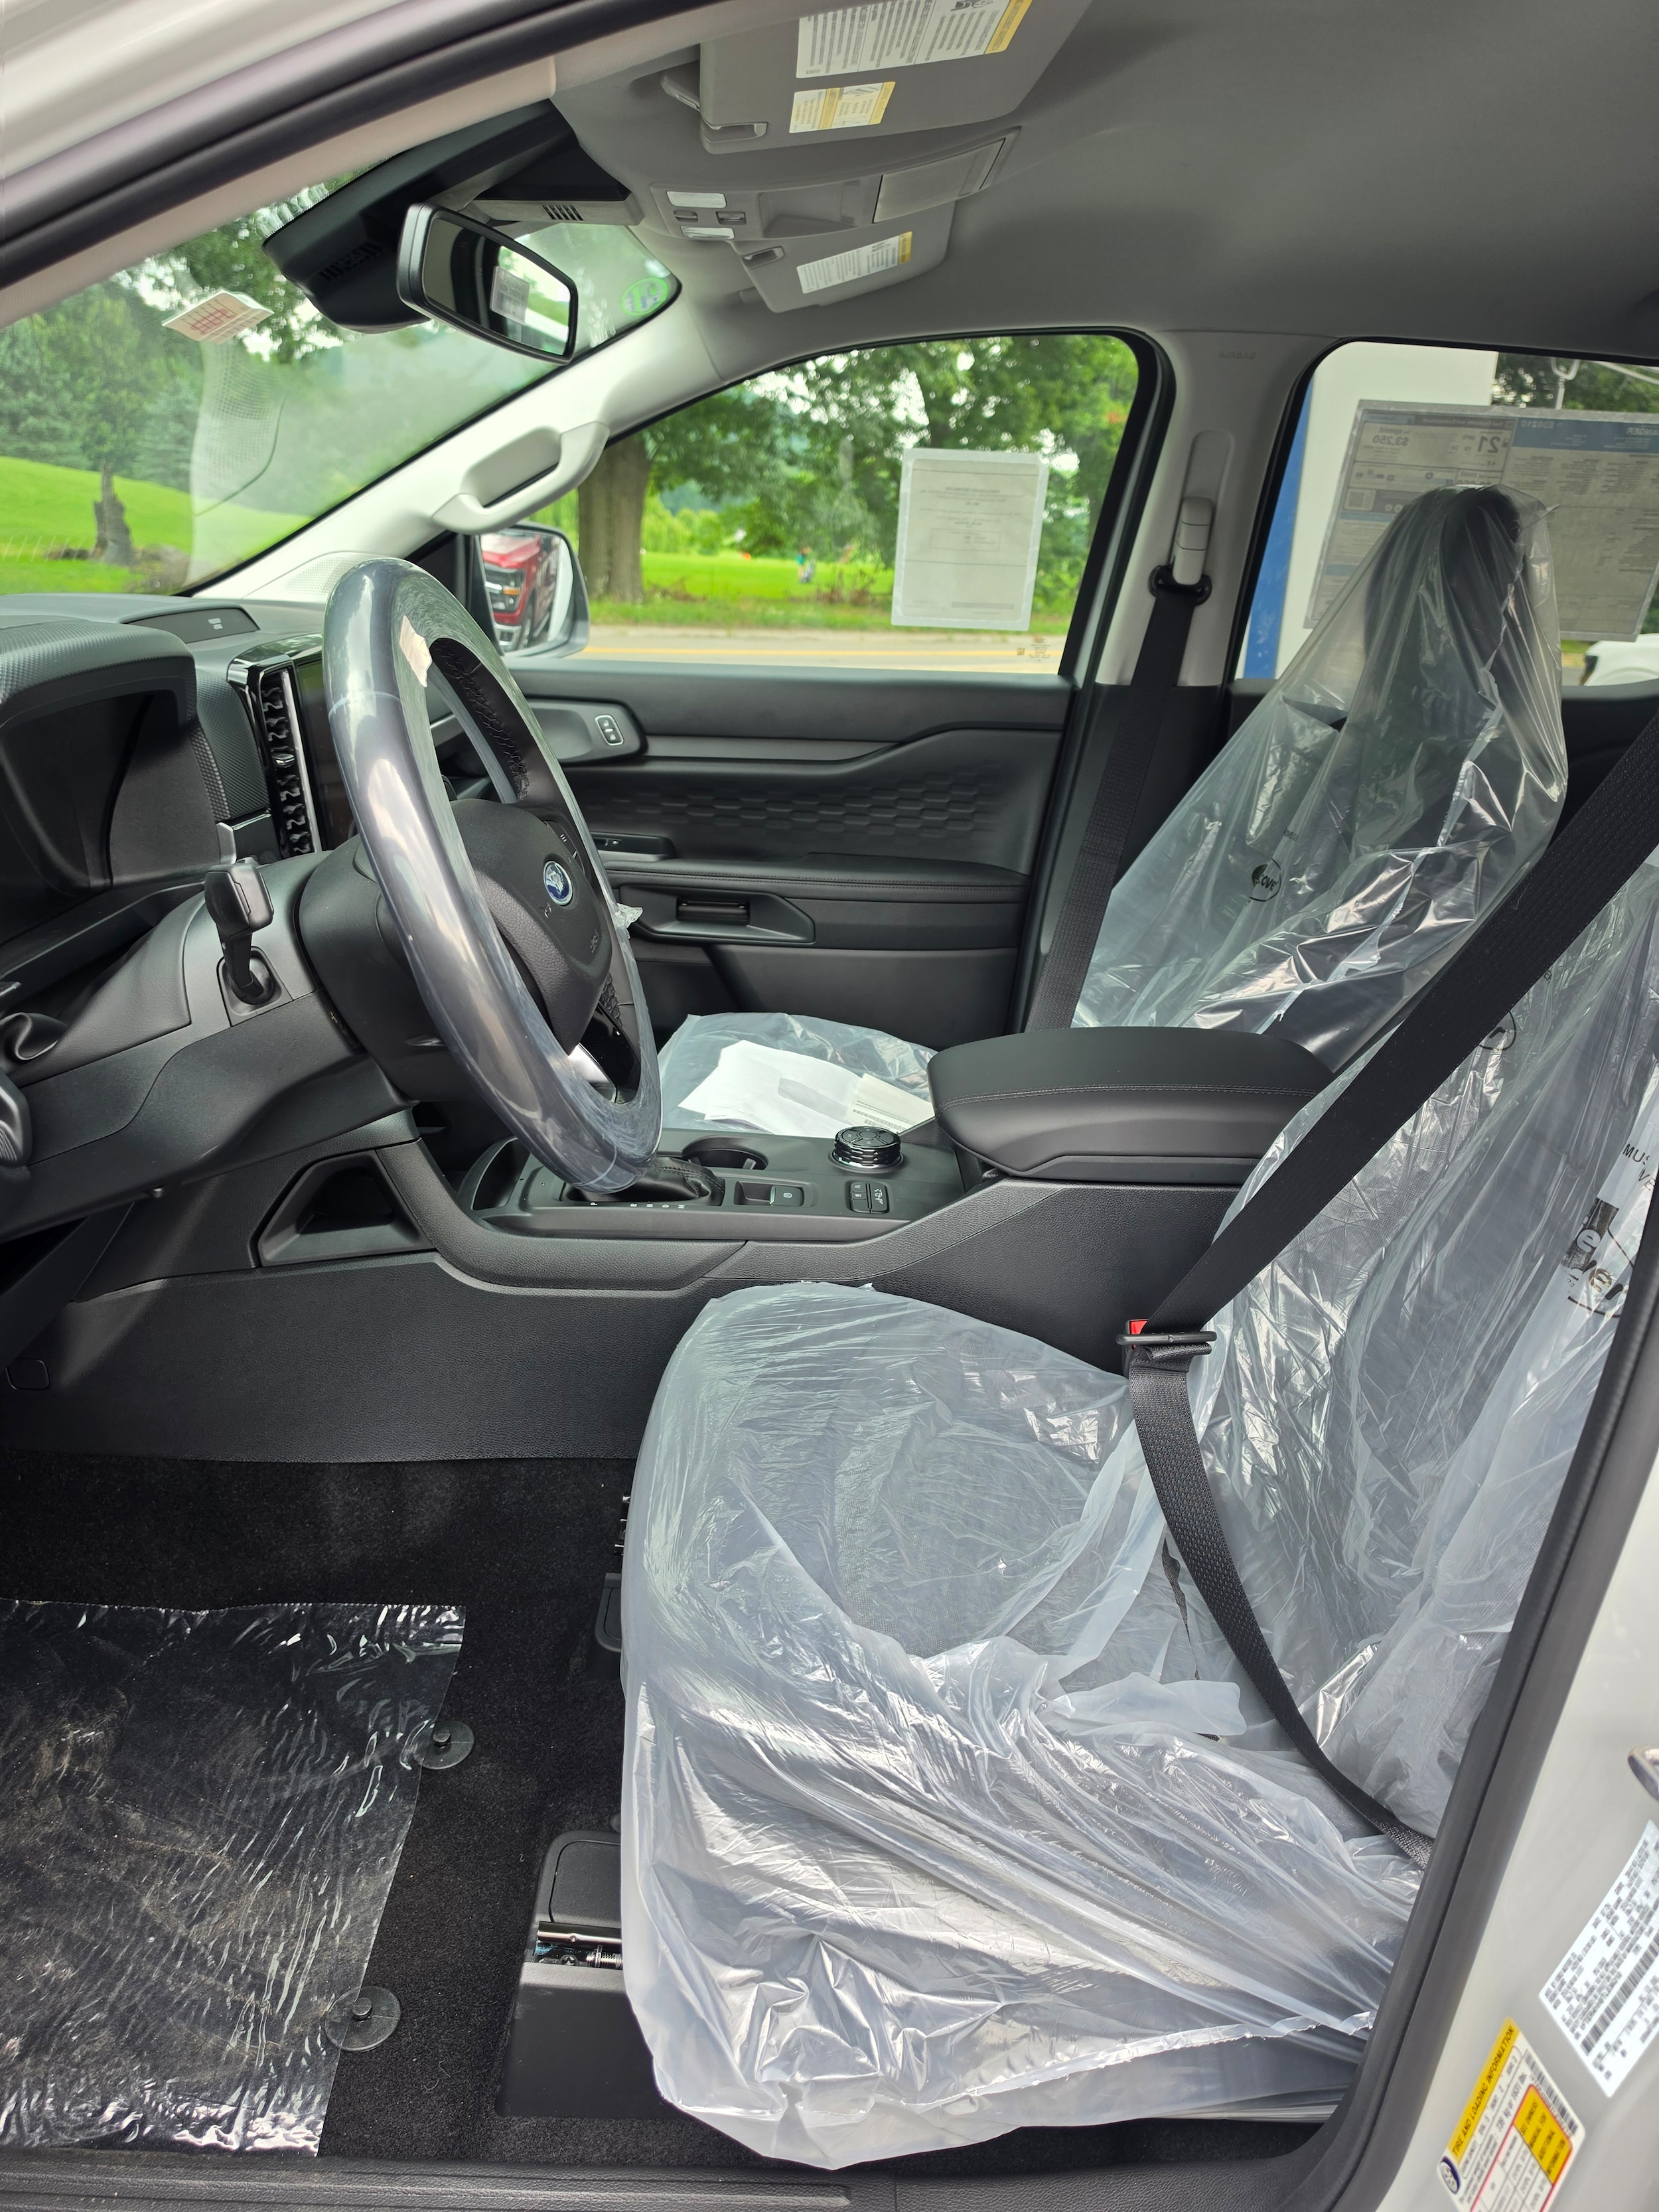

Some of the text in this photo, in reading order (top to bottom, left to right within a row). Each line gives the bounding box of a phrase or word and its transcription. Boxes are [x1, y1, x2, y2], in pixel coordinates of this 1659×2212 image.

[1452, 2135, 1464, 2157] TIRE
[1461, 2118, 1472, 2138] AND
[1469, 2082, 1488, 2120] LOADING
[1485, 2025, 1514, 2084] INFORMATION
